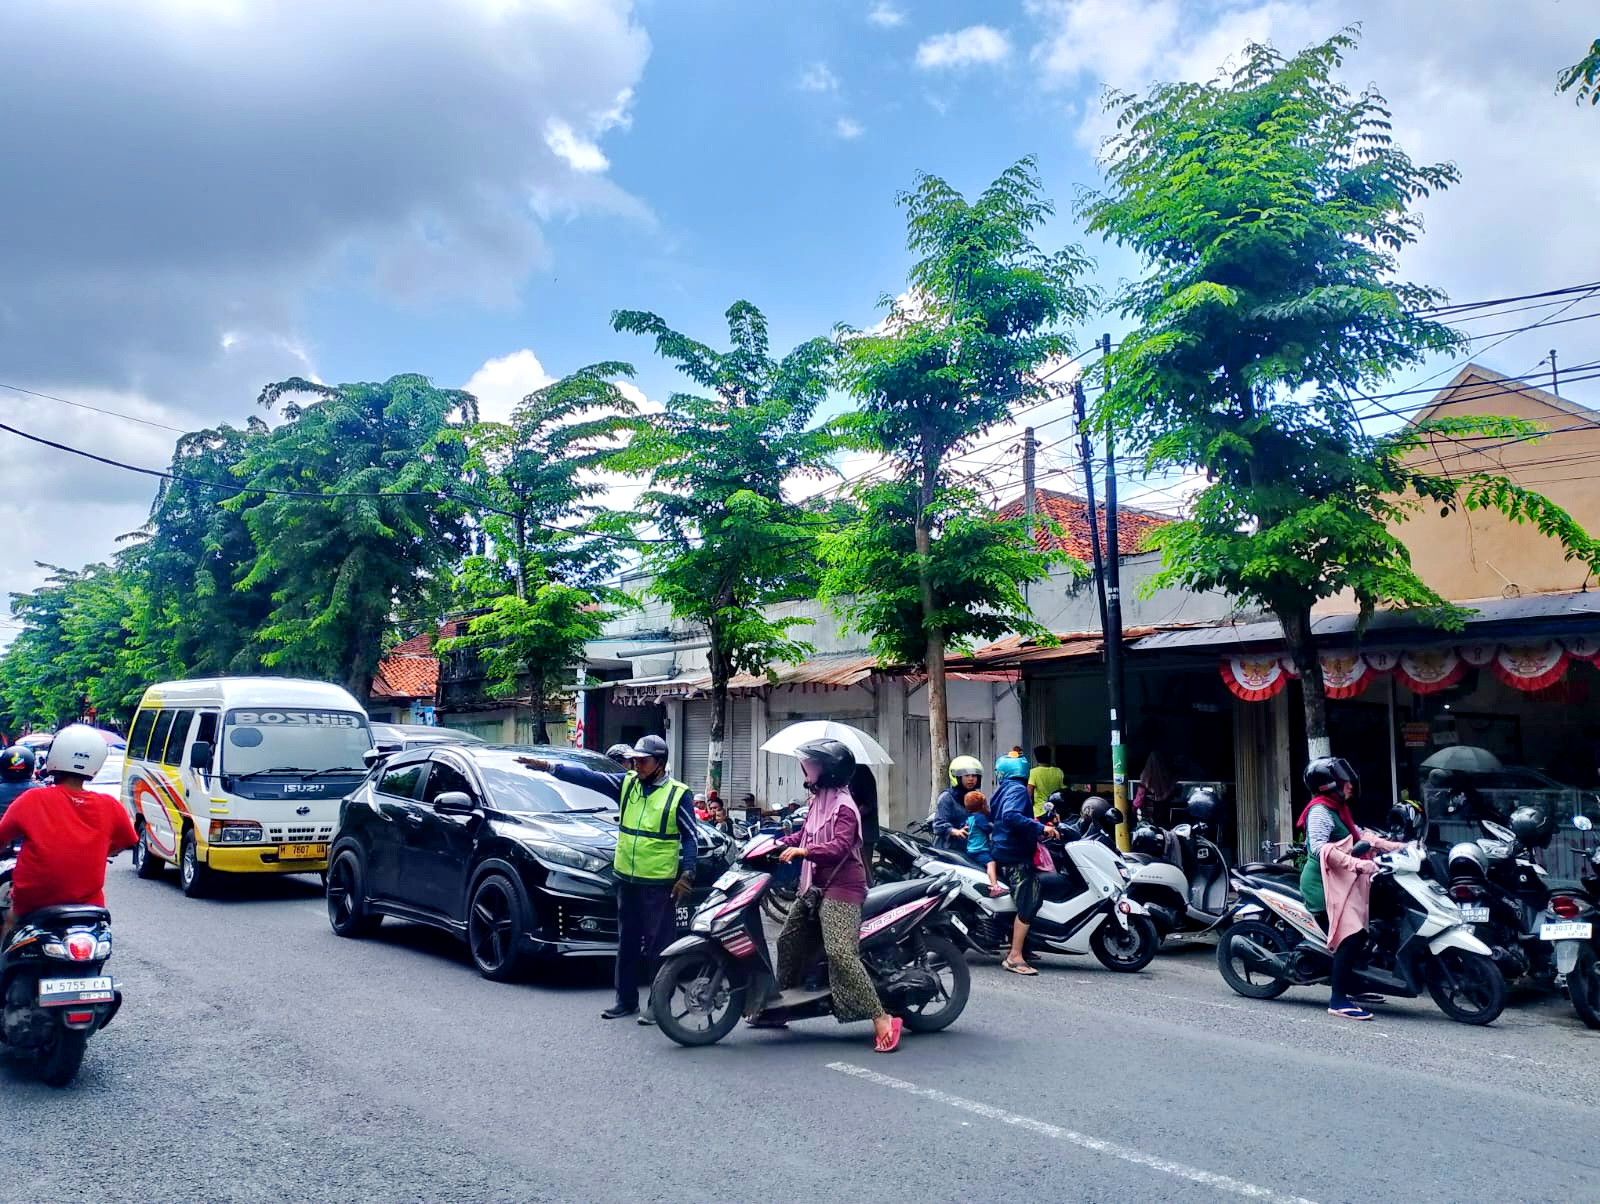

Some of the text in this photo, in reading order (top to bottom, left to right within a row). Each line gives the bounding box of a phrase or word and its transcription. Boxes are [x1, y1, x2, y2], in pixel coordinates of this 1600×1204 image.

[284, 784, 325, 793] ISUZU
[59, 981, 86, 991] 5755
[93, 980, 107, 989] CA
